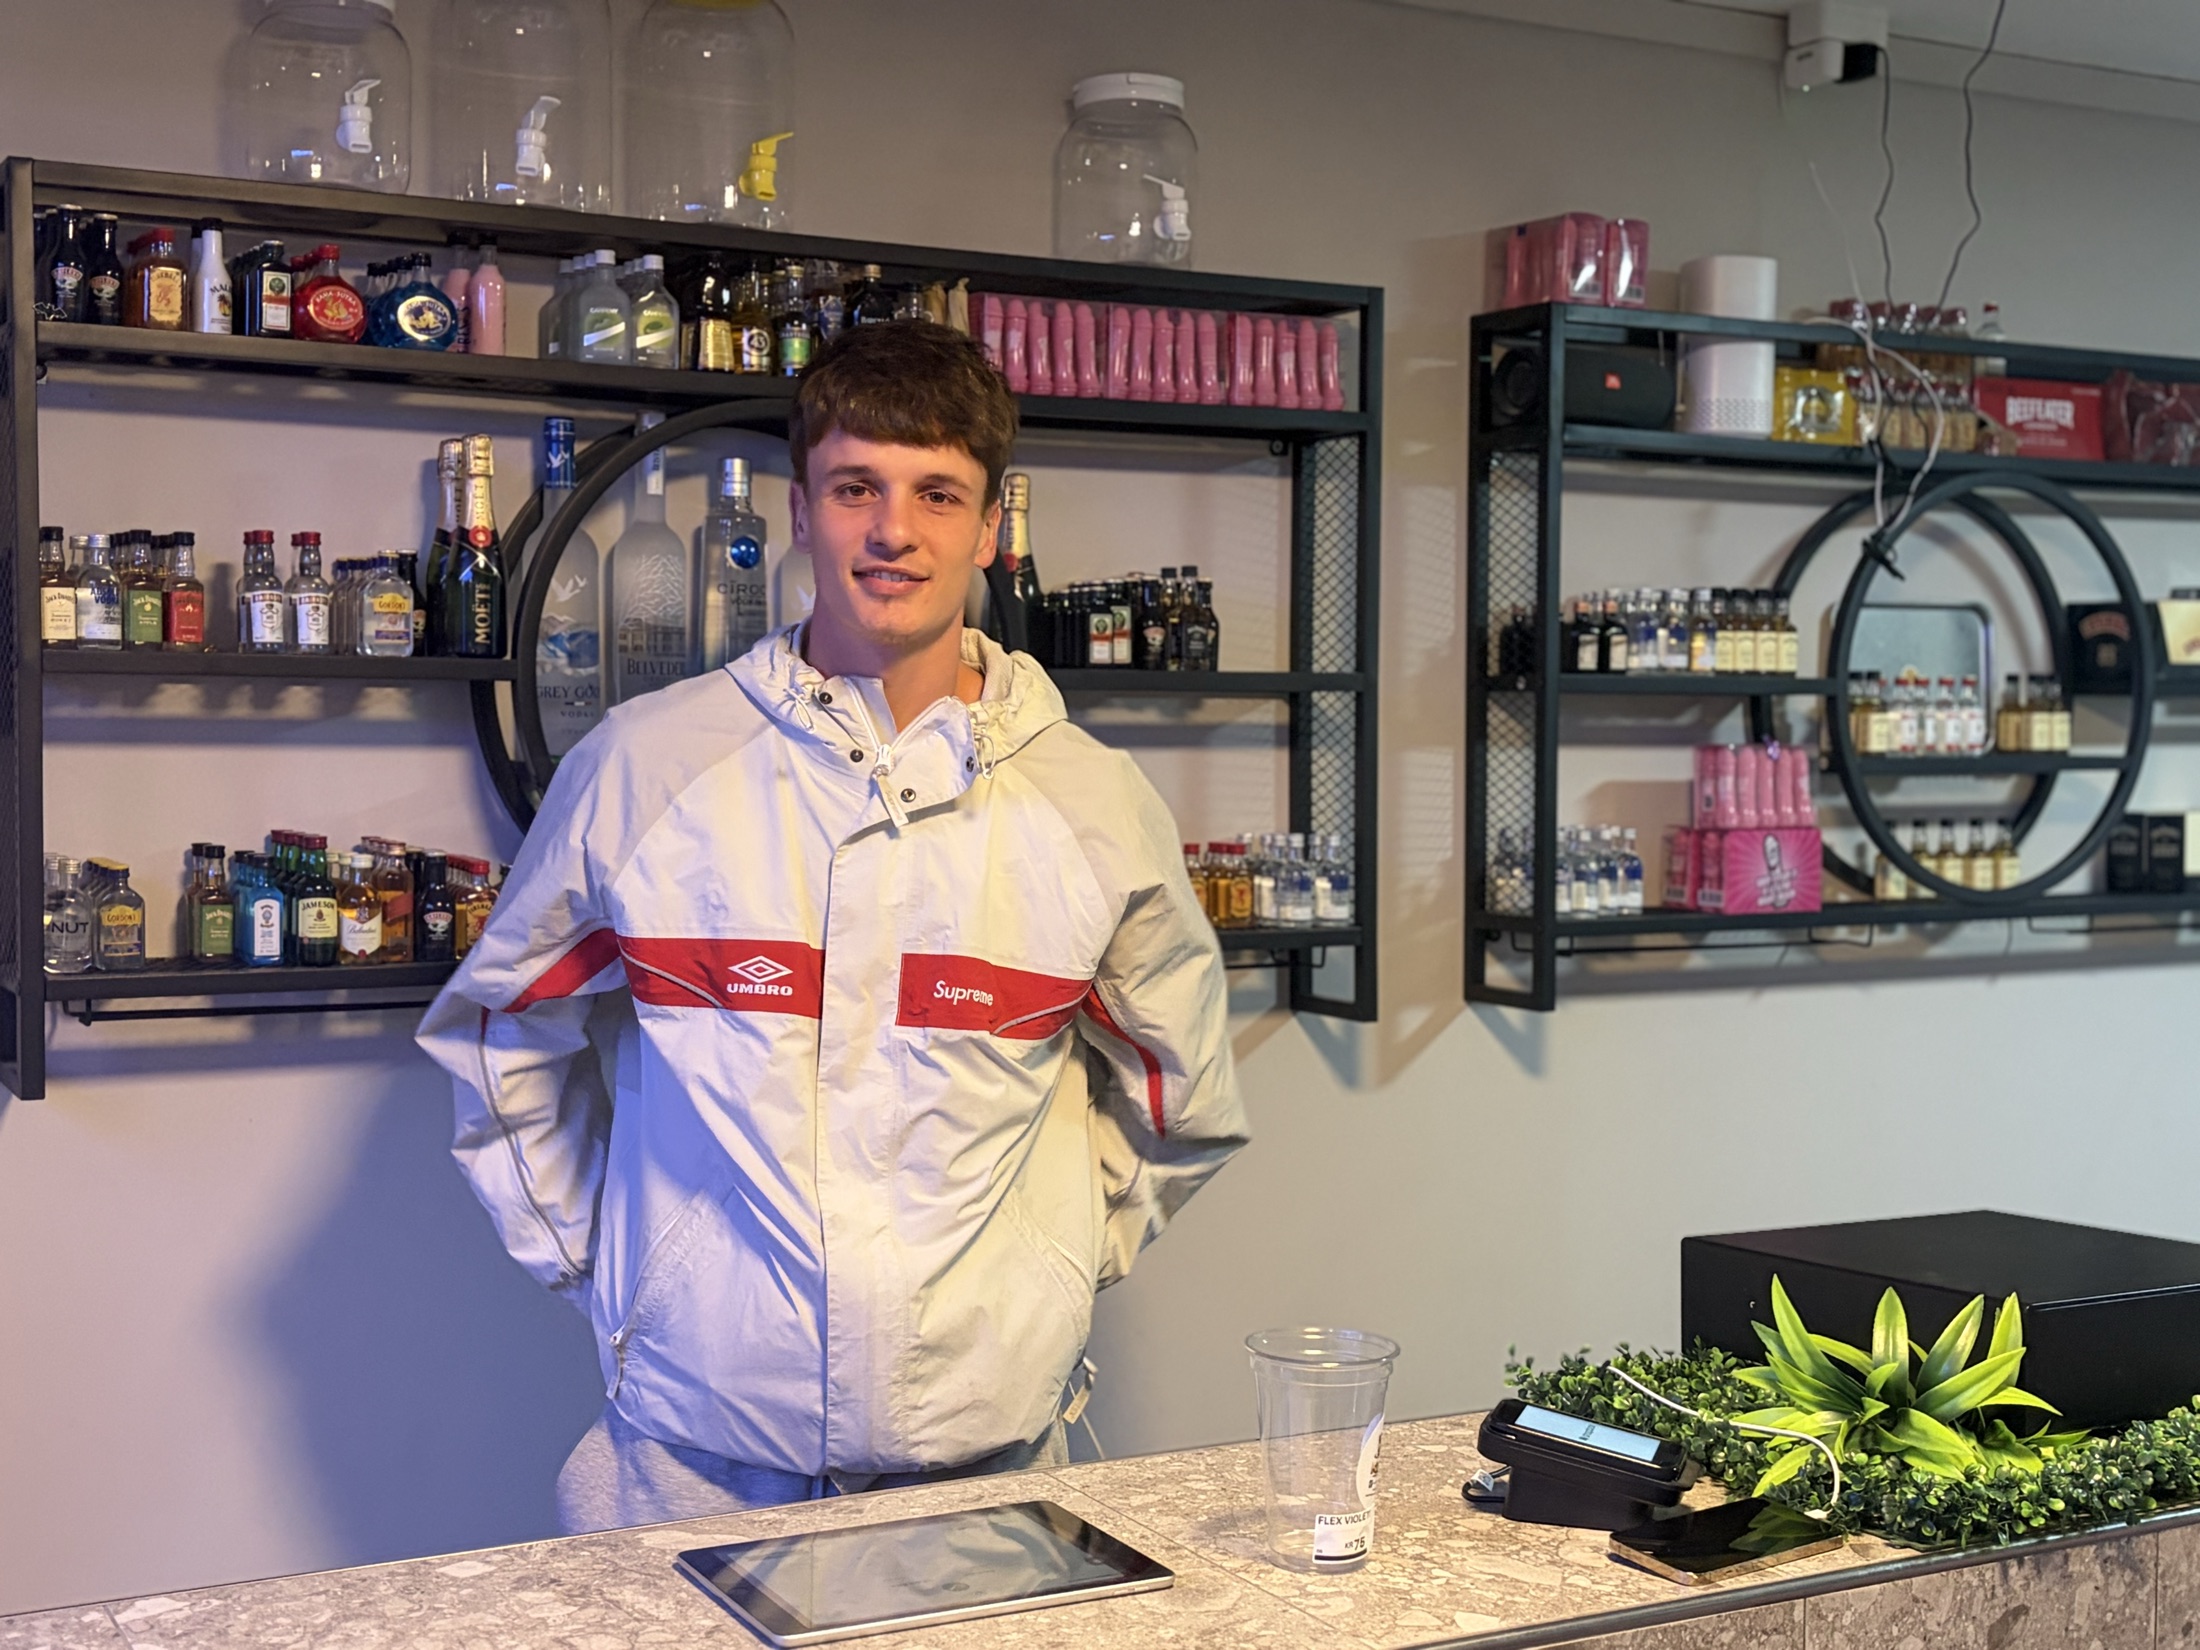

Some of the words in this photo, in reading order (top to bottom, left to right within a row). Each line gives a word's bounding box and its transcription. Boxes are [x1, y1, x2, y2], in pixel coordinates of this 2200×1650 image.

[51, 922, 89, 934] NUT
[727, 983, 793, 997] UMBRO
[932, 979, 994, 1007] Supreme
[1318, 1516, 1342, 1525] FLEX
[1345, 1511, 1371, 1525] VIOLET
[1354, 1537, 1366, 1550] 75
